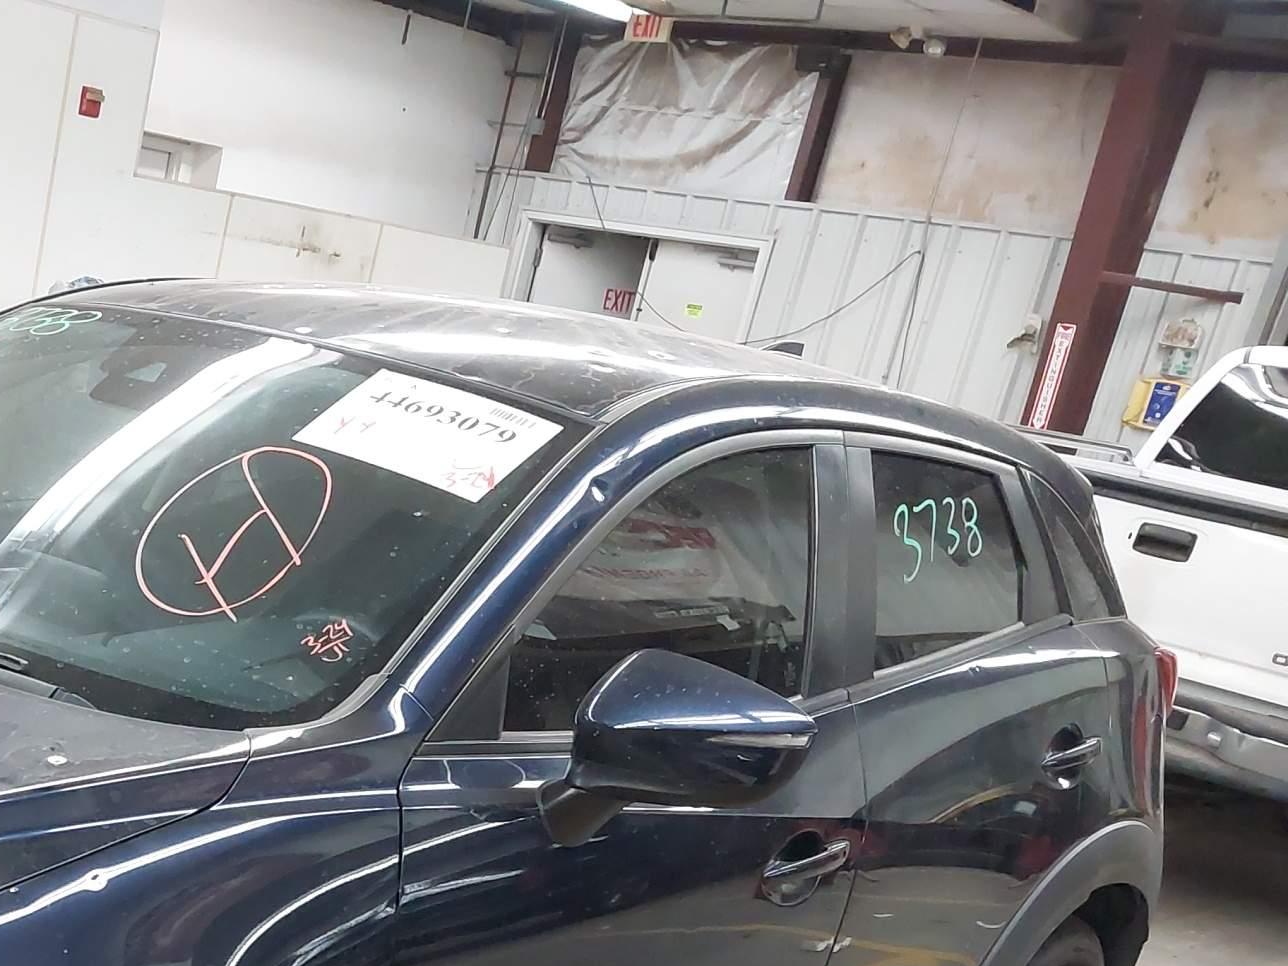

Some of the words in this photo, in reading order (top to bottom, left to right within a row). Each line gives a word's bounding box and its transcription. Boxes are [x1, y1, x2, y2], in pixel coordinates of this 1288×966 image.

[633, 15, 662, 38] EXIT
[603, 289, 636, 313] EXIT
[370, 391, 517, 443] 44693079
